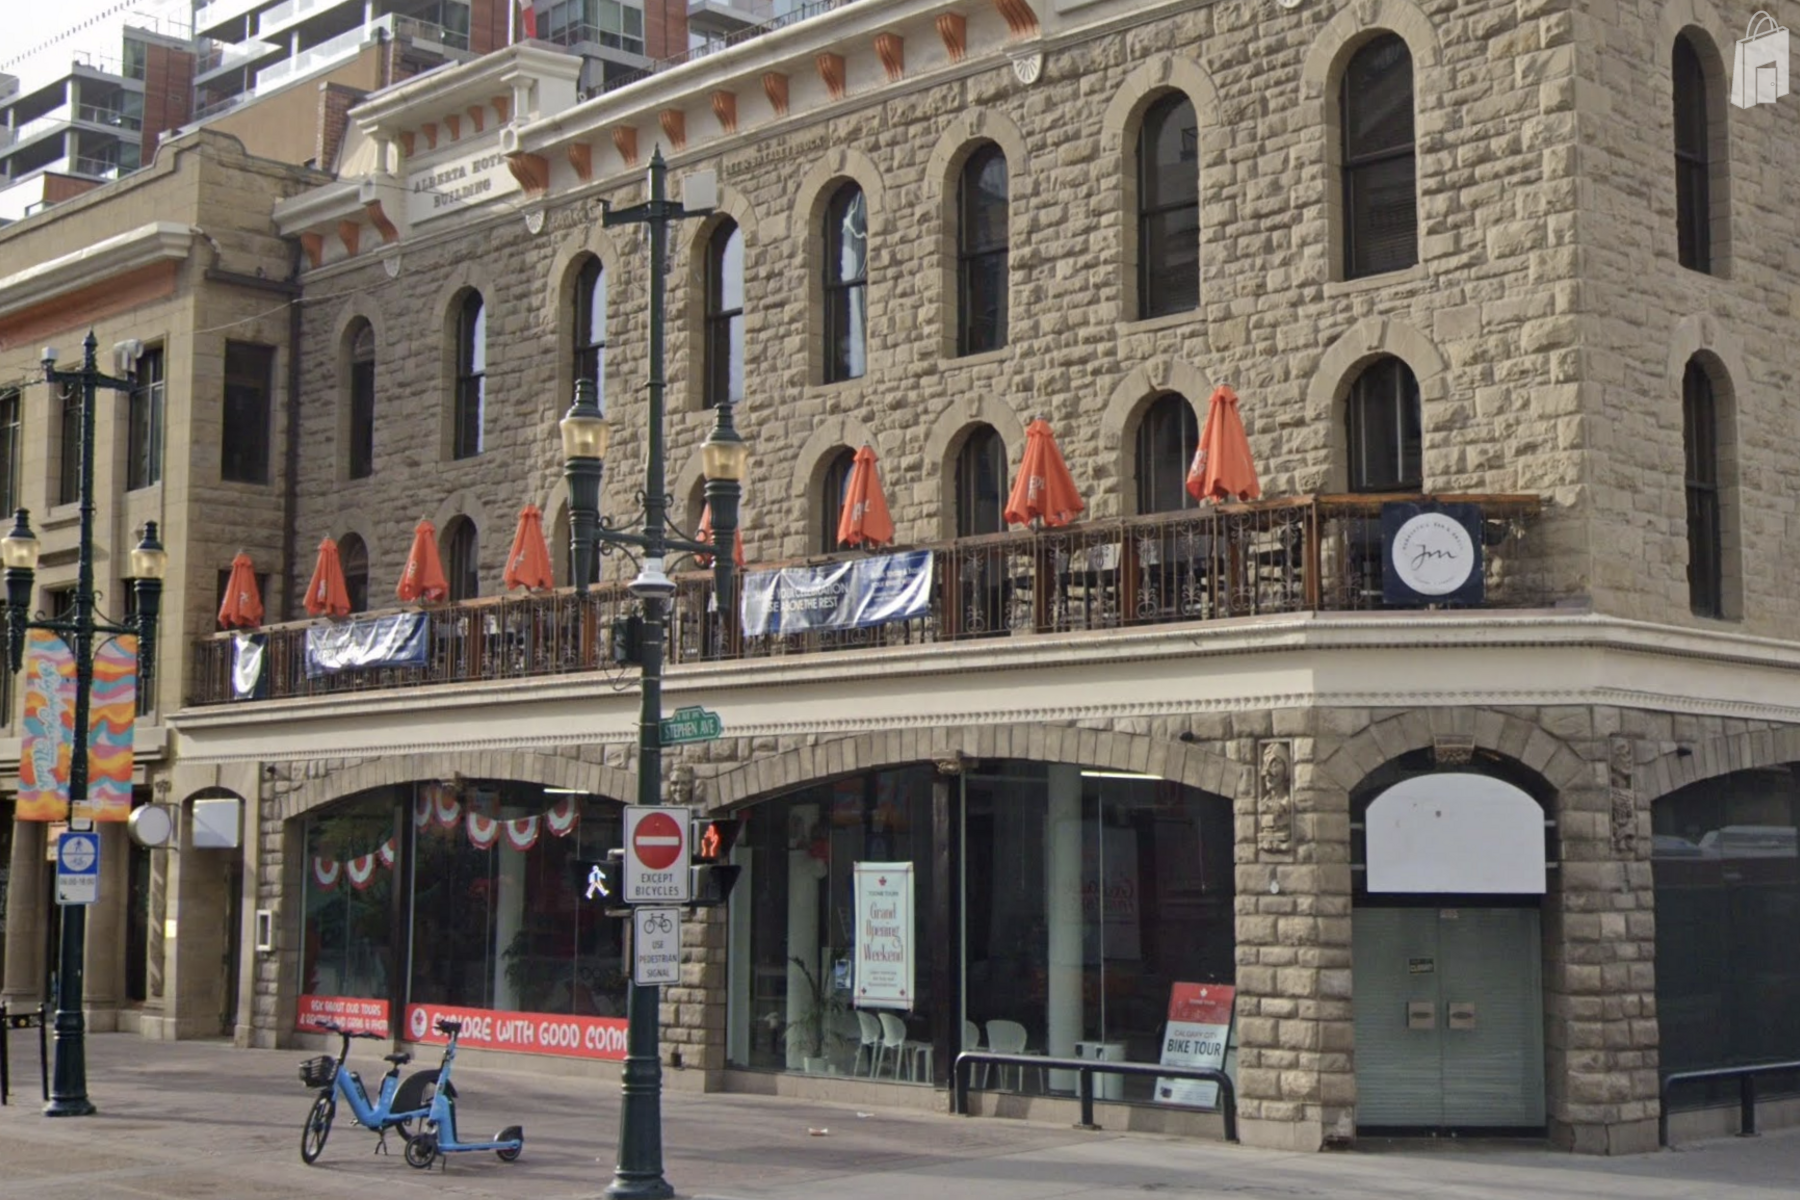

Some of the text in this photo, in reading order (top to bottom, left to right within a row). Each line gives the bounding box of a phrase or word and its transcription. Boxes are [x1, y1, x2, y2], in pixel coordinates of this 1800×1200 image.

[414, 166, 466, 194] ALBERTA
[433, 178, 491, 208] BUILDING
[804, 598, 818, 610] THE
[819, 596, 838, 608] REST
[665, 719, 714, 740] STEPHEN AVE
[641, 873, 673, 883] EXCEPT
[635, 886, 679, 896] BICYCLES
[870, 901, 896, 920] Grand
[866, 920, 902, 949] Opening
[652, 941, 664, 950] USE
[863, 943, 904, 962] Weekend
[639, 954, 677, 963] PEDESTRIAN
[646, 968, 670, 978] SIGNAL
[346, 1002, 359, 1014] OUR
[361, 1003, 381, 1016] TOURS
[496, 1019, 534, 1043] WITH
[539, 1021, 579, 1047] GOOD
[1174, 1029, 1217, 1040] CALGARY CITY
[1167, 1039, 1221, 1057] BIKE TOUR
